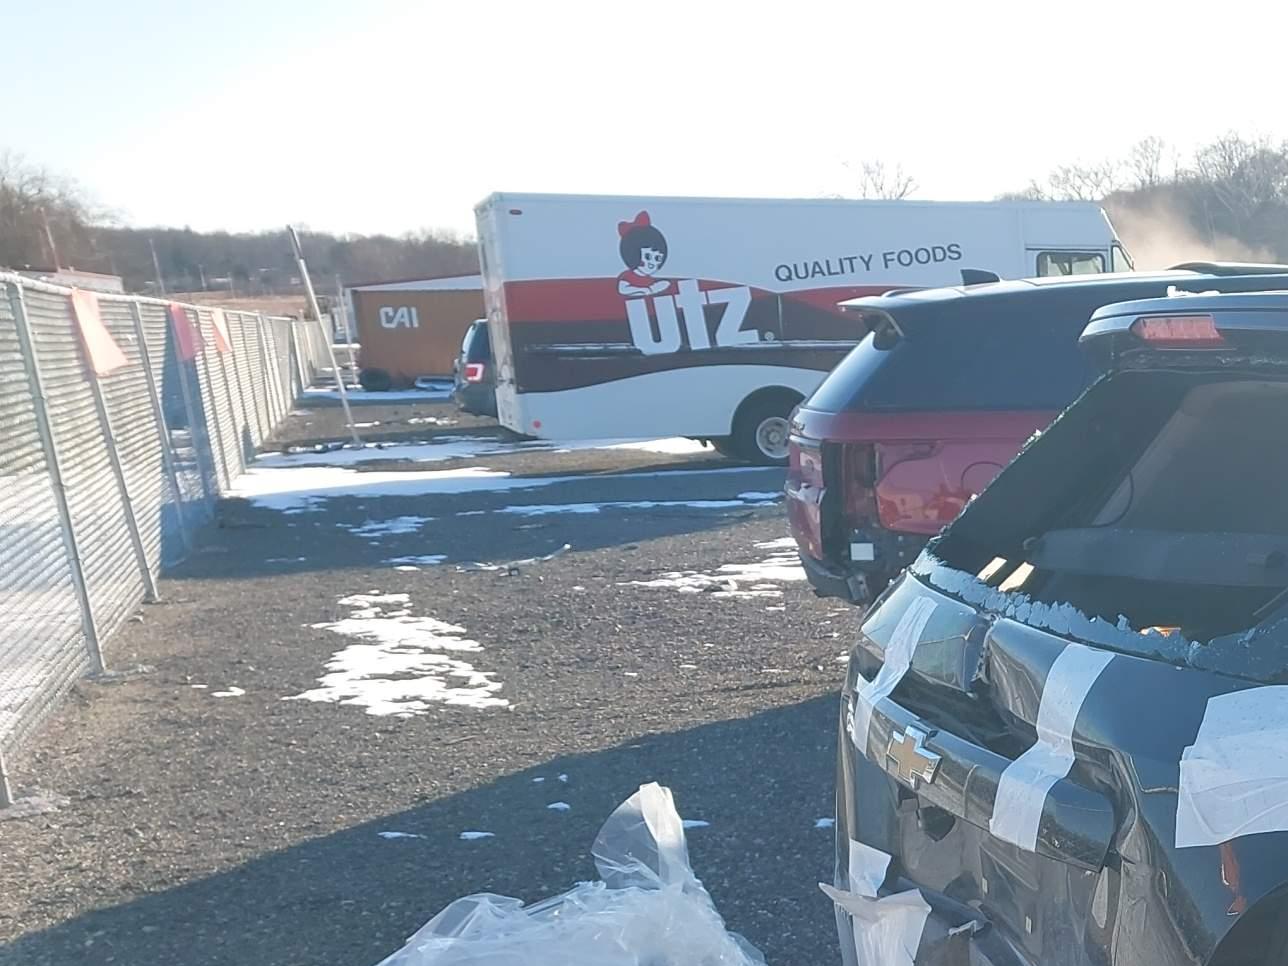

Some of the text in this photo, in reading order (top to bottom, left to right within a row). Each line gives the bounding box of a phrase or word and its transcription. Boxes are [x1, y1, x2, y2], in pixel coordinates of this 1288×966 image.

[775, 243, 962, 282] QUALITY FOODS
[379, 306, 420, 328] CAI
